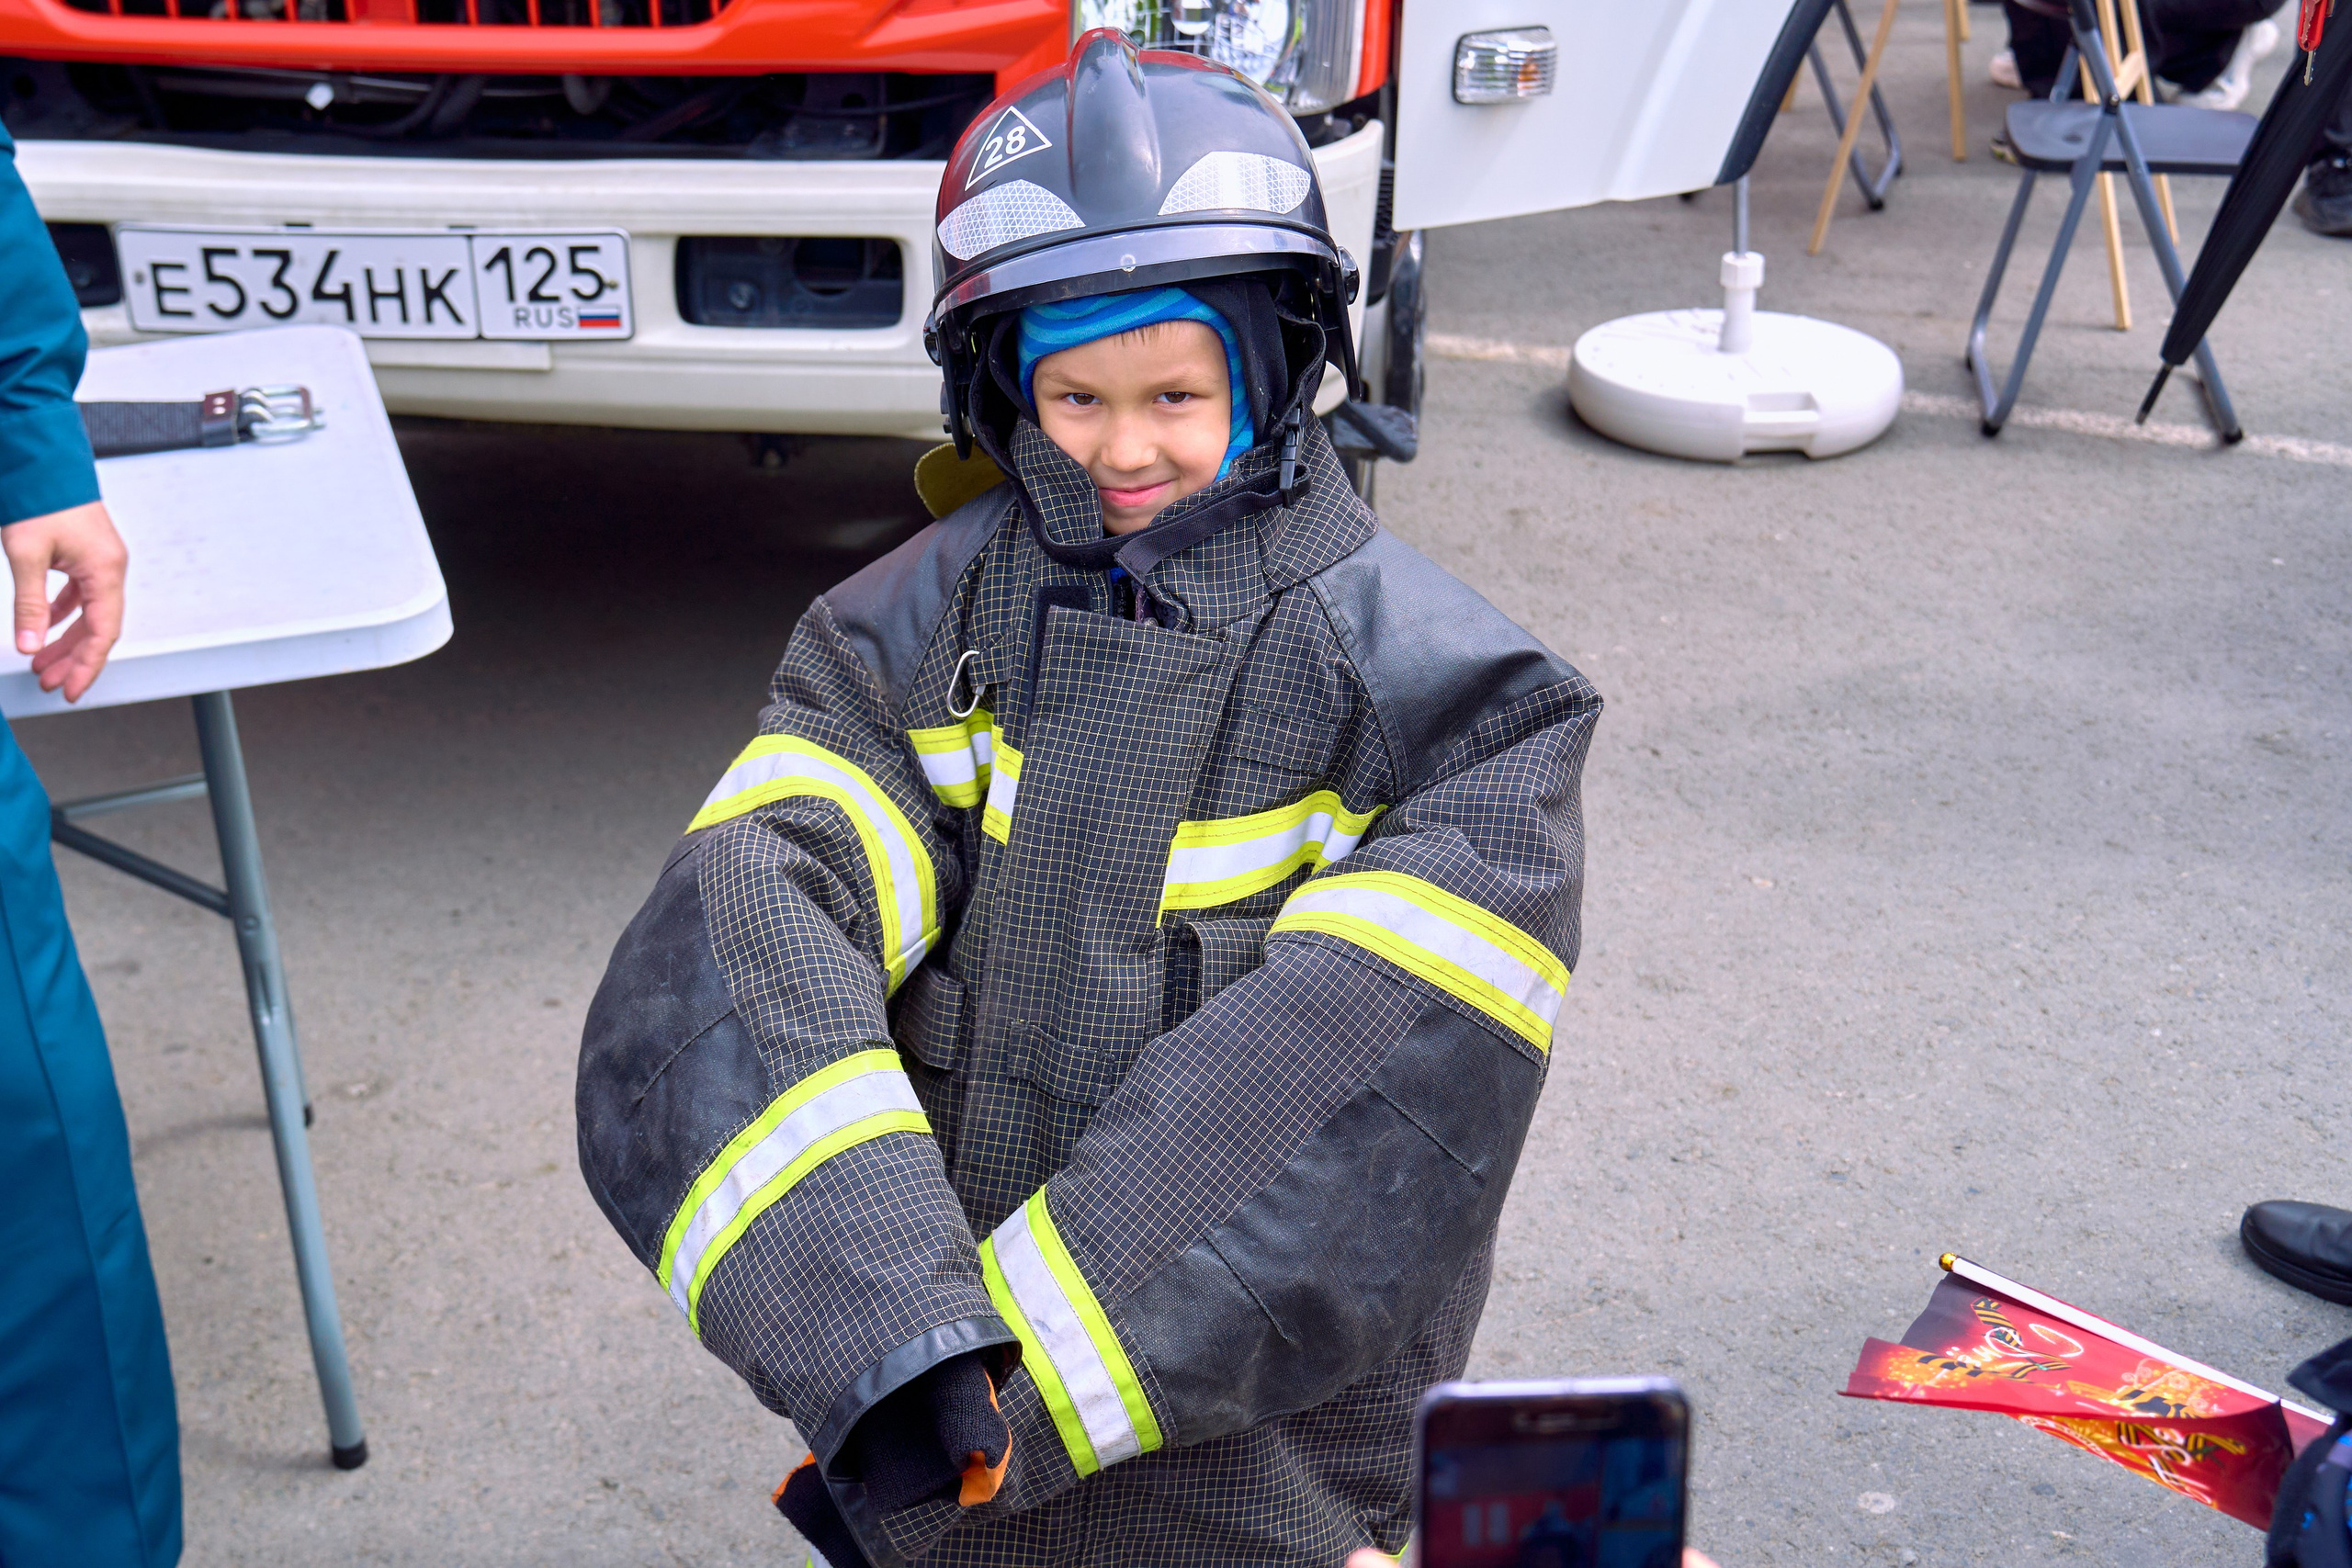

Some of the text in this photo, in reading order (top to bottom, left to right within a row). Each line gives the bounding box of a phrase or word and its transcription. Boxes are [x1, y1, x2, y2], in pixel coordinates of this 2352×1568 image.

[984, 125, 1026, 169] 28
[484, 245, 605, 303] 125
[514, 306, 575, 329] RUS
